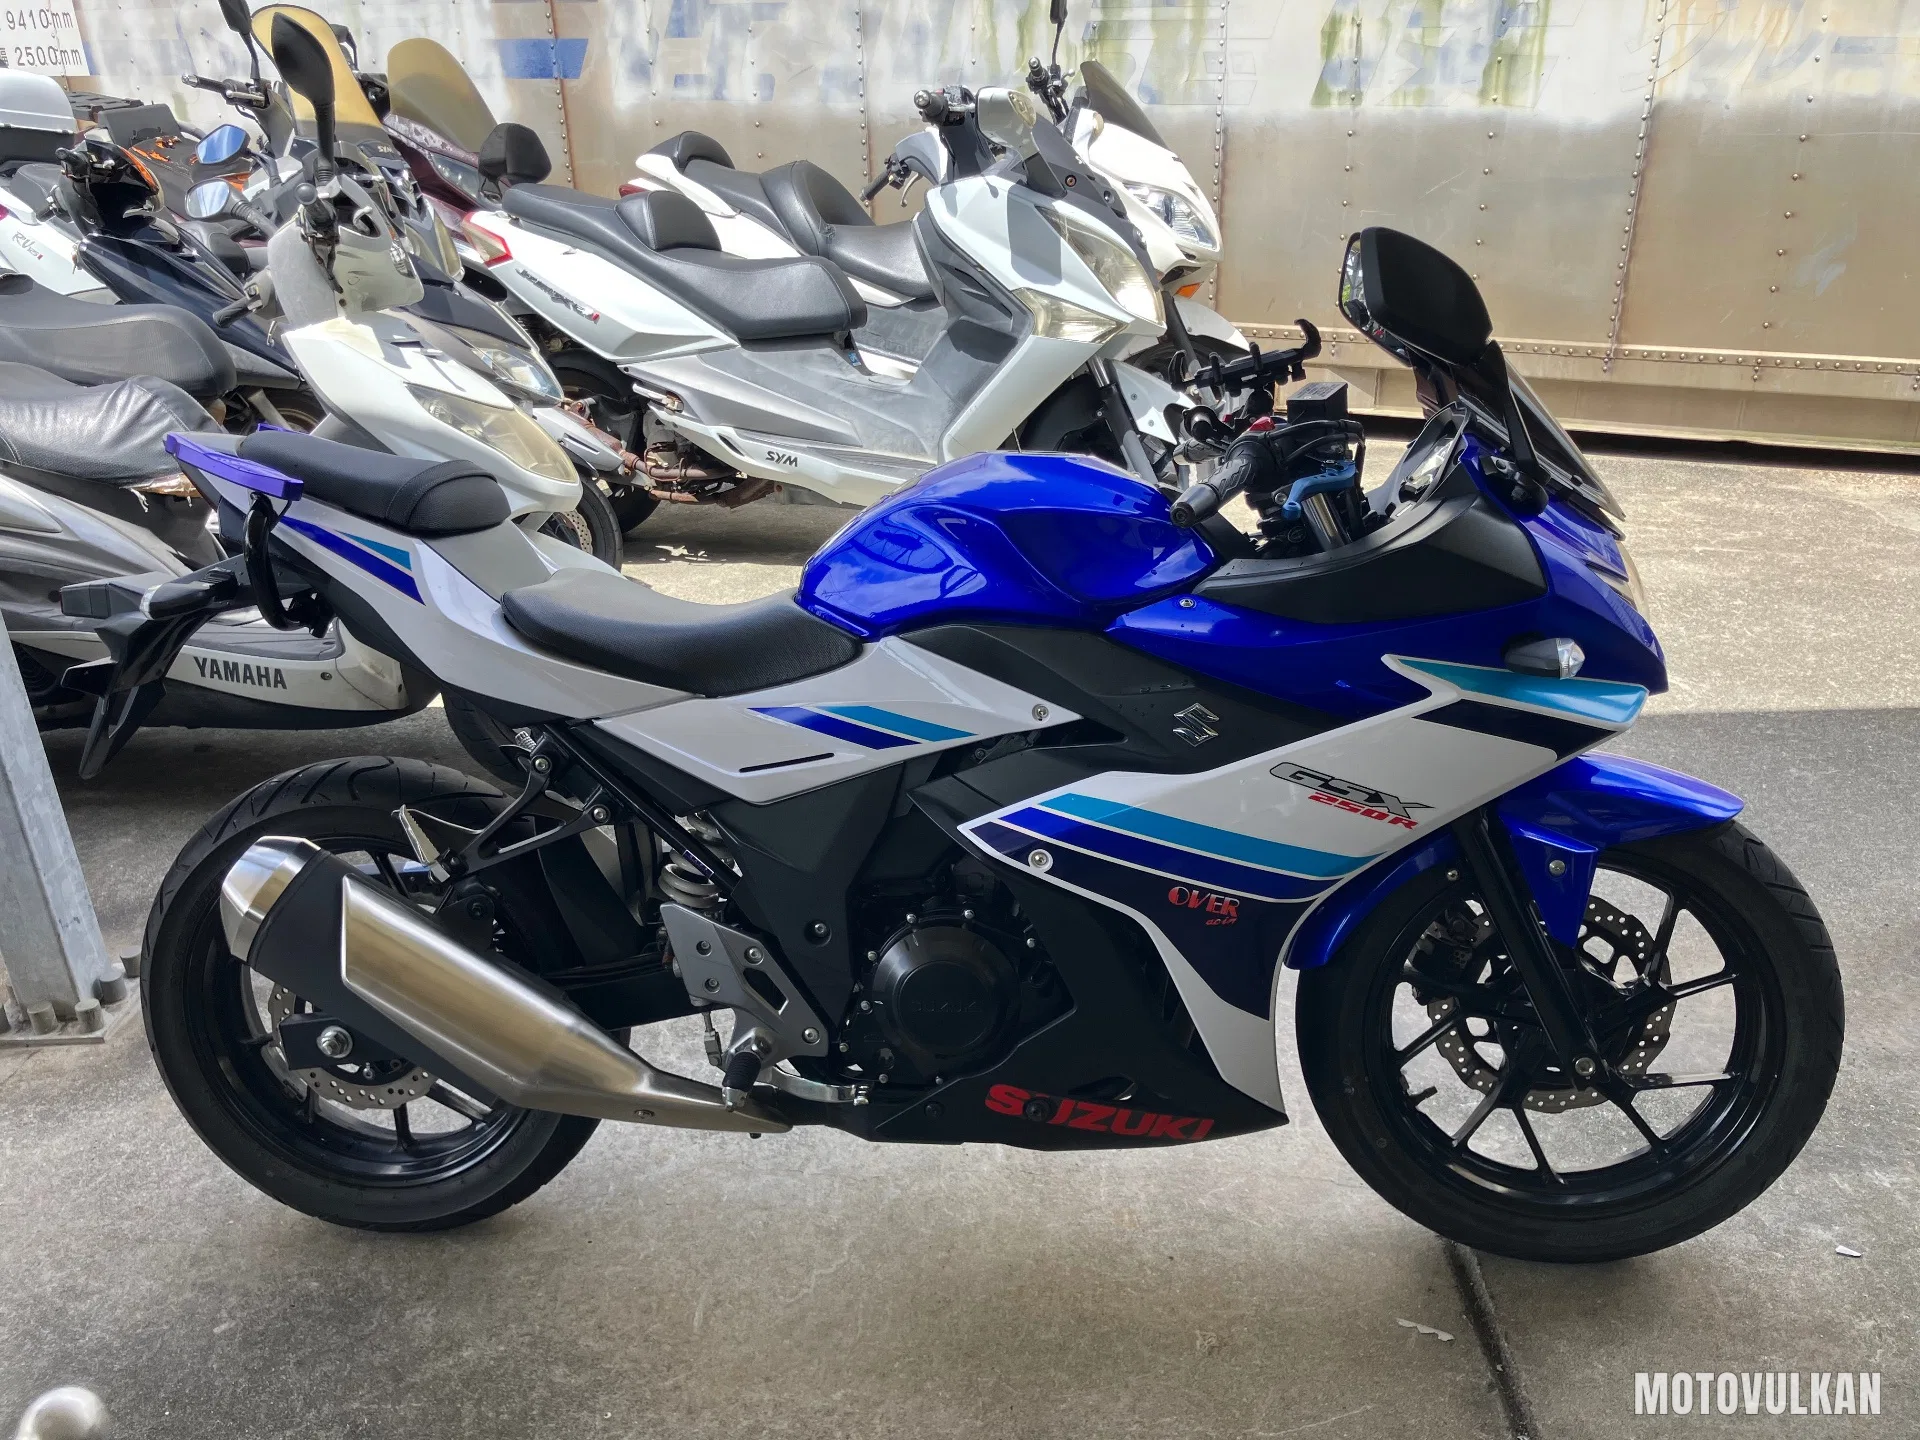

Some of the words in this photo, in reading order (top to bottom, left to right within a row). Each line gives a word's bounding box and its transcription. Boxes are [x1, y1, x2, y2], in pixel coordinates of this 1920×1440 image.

[765, 450, 798, 468] SYM
[193, 656, 288, 690] YAMAHA
[1269, 761, 1436, 820] GSX
[1168, 886, 1240, 918] OVER
